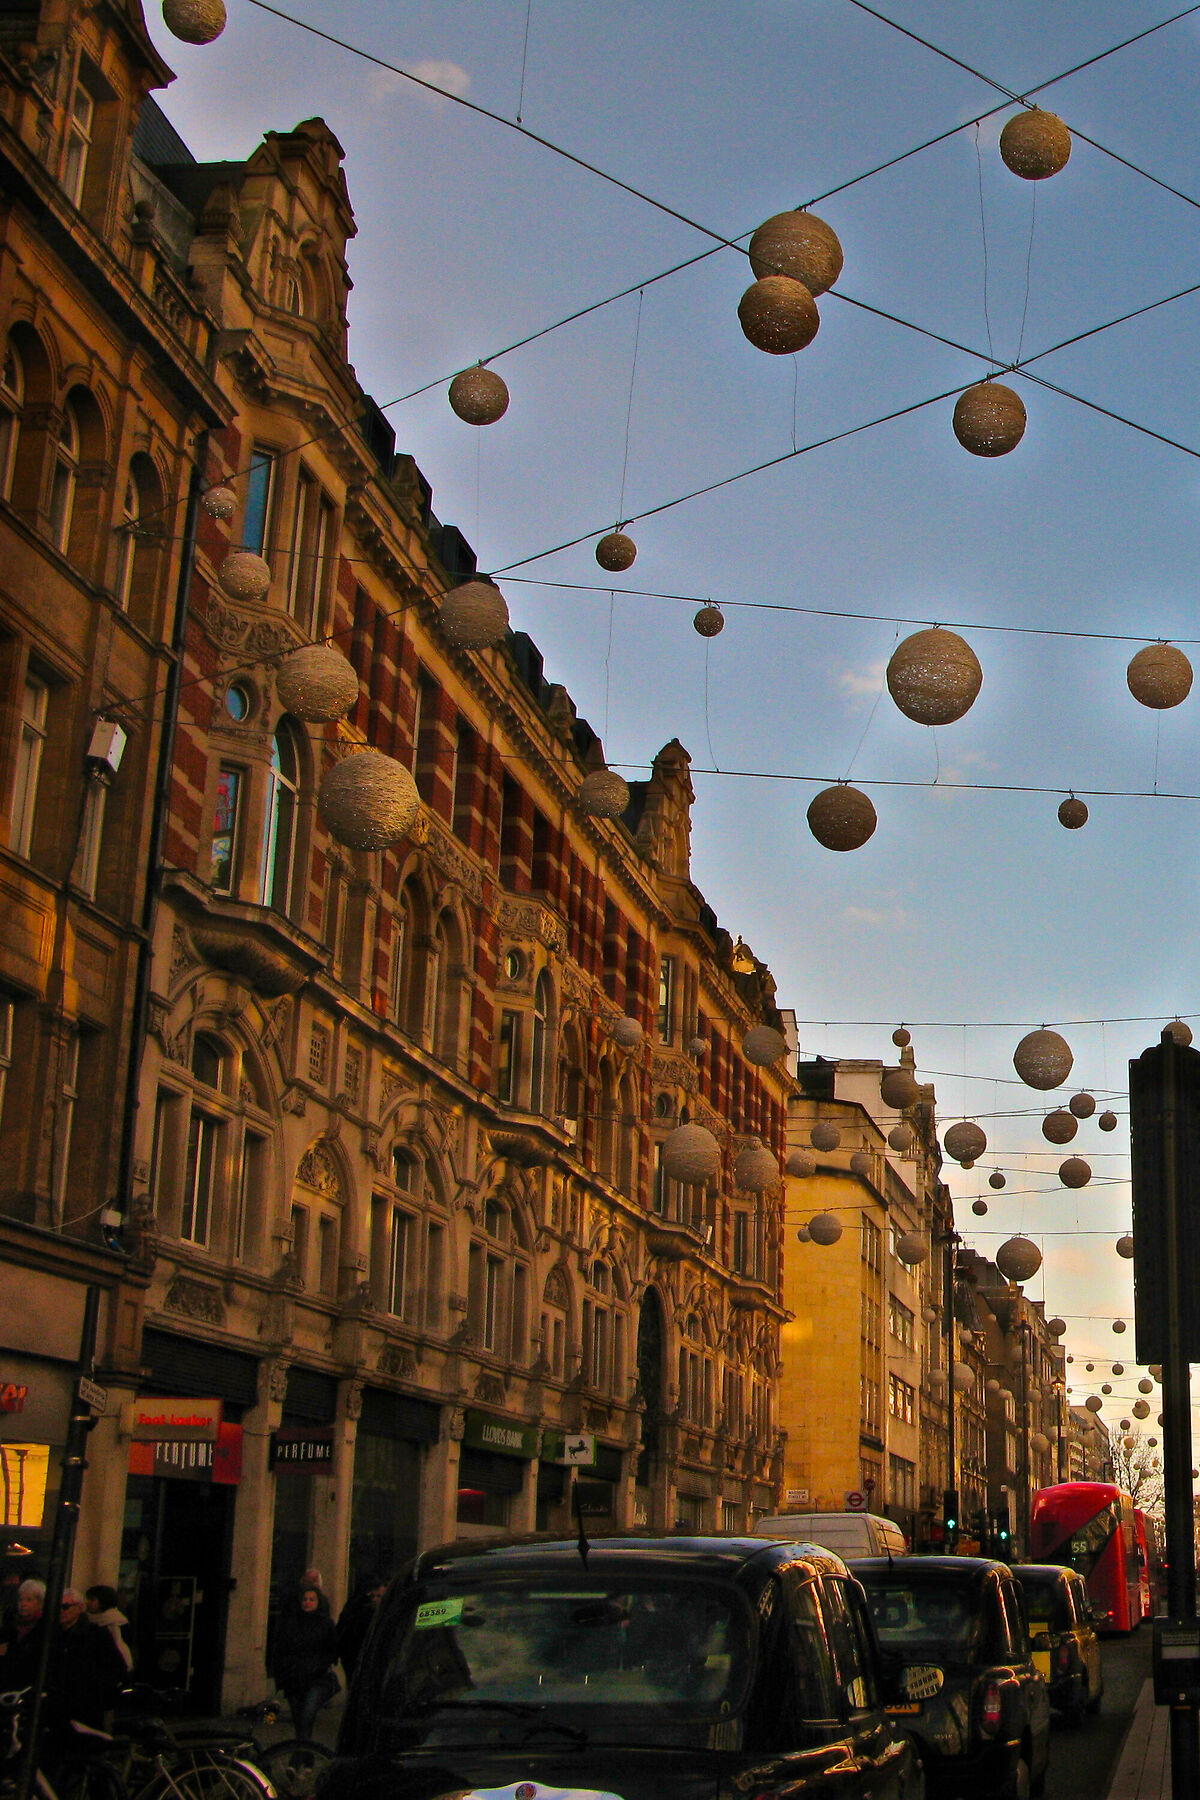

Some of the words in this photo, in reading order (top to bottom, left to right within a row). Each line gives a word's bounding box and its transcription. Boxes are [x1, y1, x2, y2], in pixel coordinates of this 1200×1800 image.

[137, 1413, 166, 1426] Foot
[169, 1413, 213, 1426] Locker
[277, 1441, 331, 1460] PERFUME
